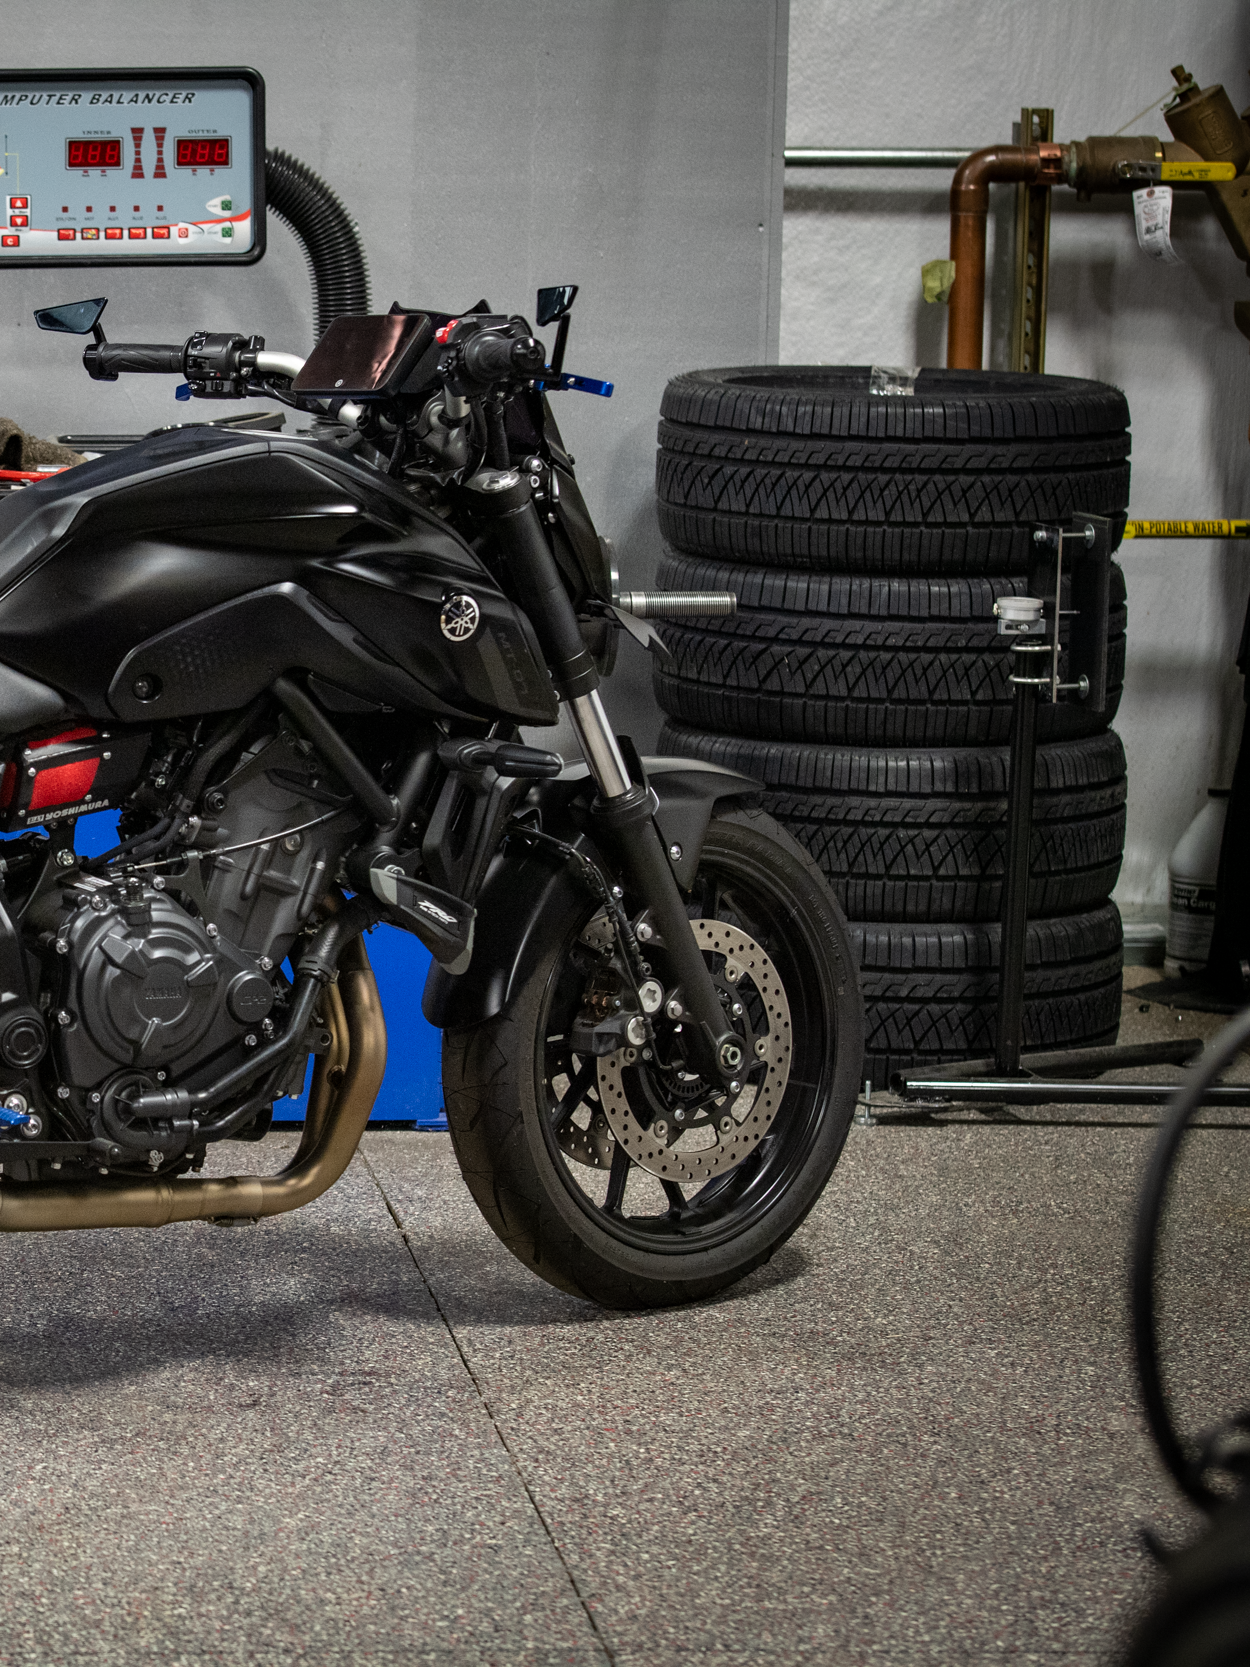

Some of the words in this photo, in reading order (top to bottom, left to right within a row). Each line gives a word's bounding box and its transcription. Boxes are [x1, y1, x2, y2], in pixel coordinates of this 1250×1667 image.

[88, 92, 196, 105] BALANCER
[1192, 521, 1224, 534] WATER
[45, 799, 109, 821] YOSHIMURA
